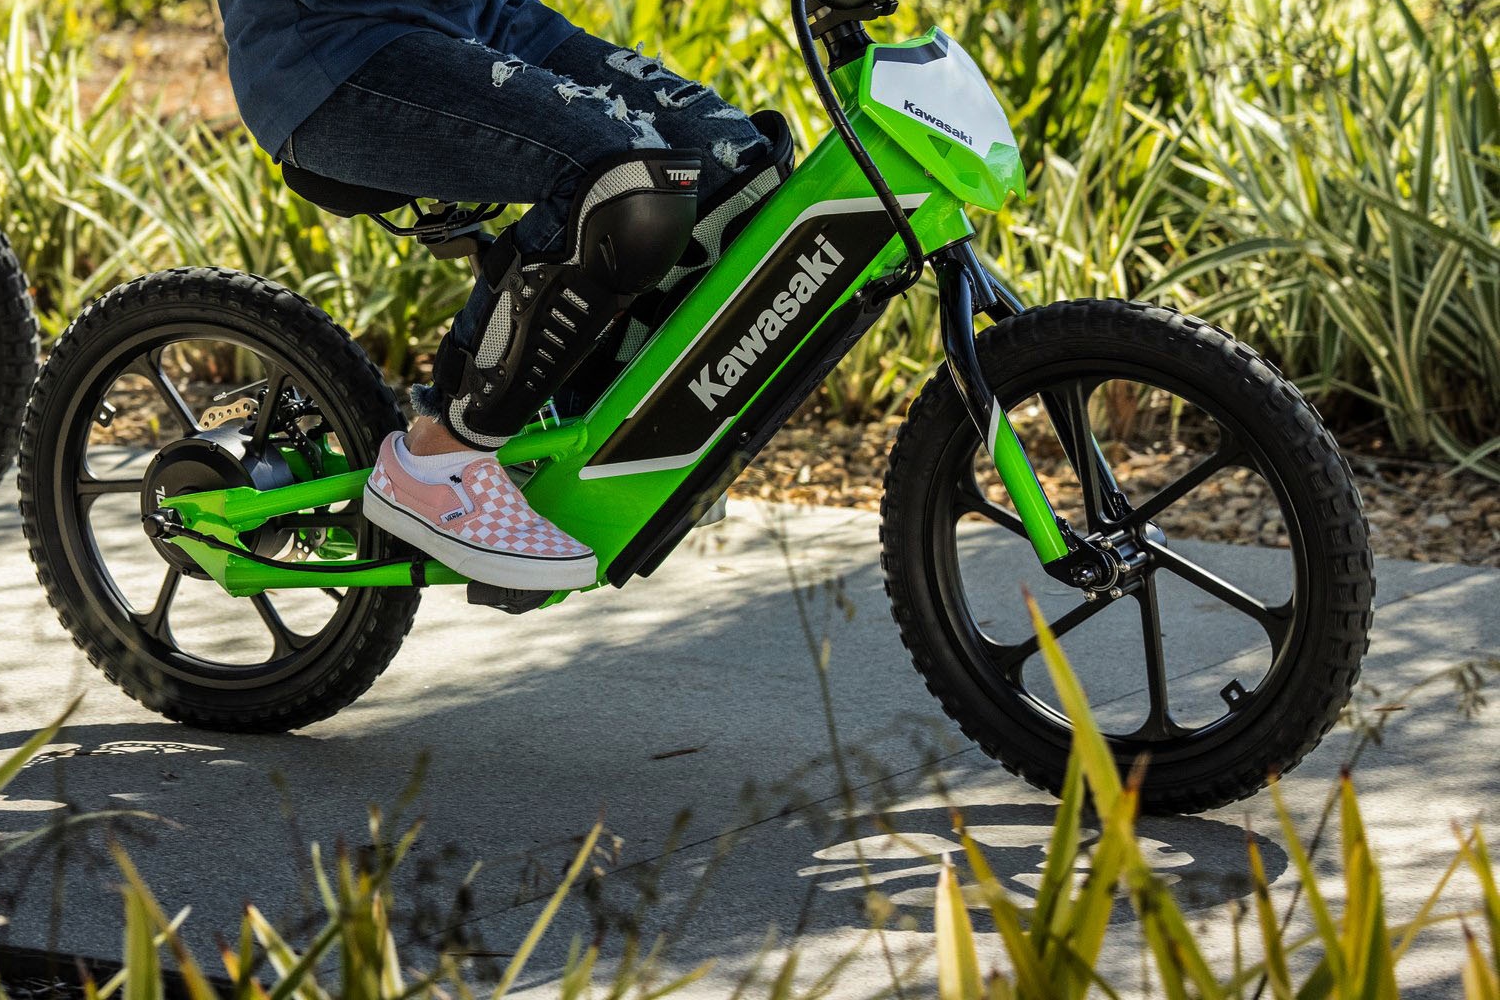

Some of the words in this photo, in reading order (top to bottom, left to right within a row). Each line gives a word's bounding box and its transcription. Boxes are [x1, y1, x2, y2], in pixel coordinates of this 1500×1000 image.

[903, 100, 973, 146] Kawasaki
[666, 169, 701, 181] TITAN
[688, 233, 845, 412] Kawasaki
